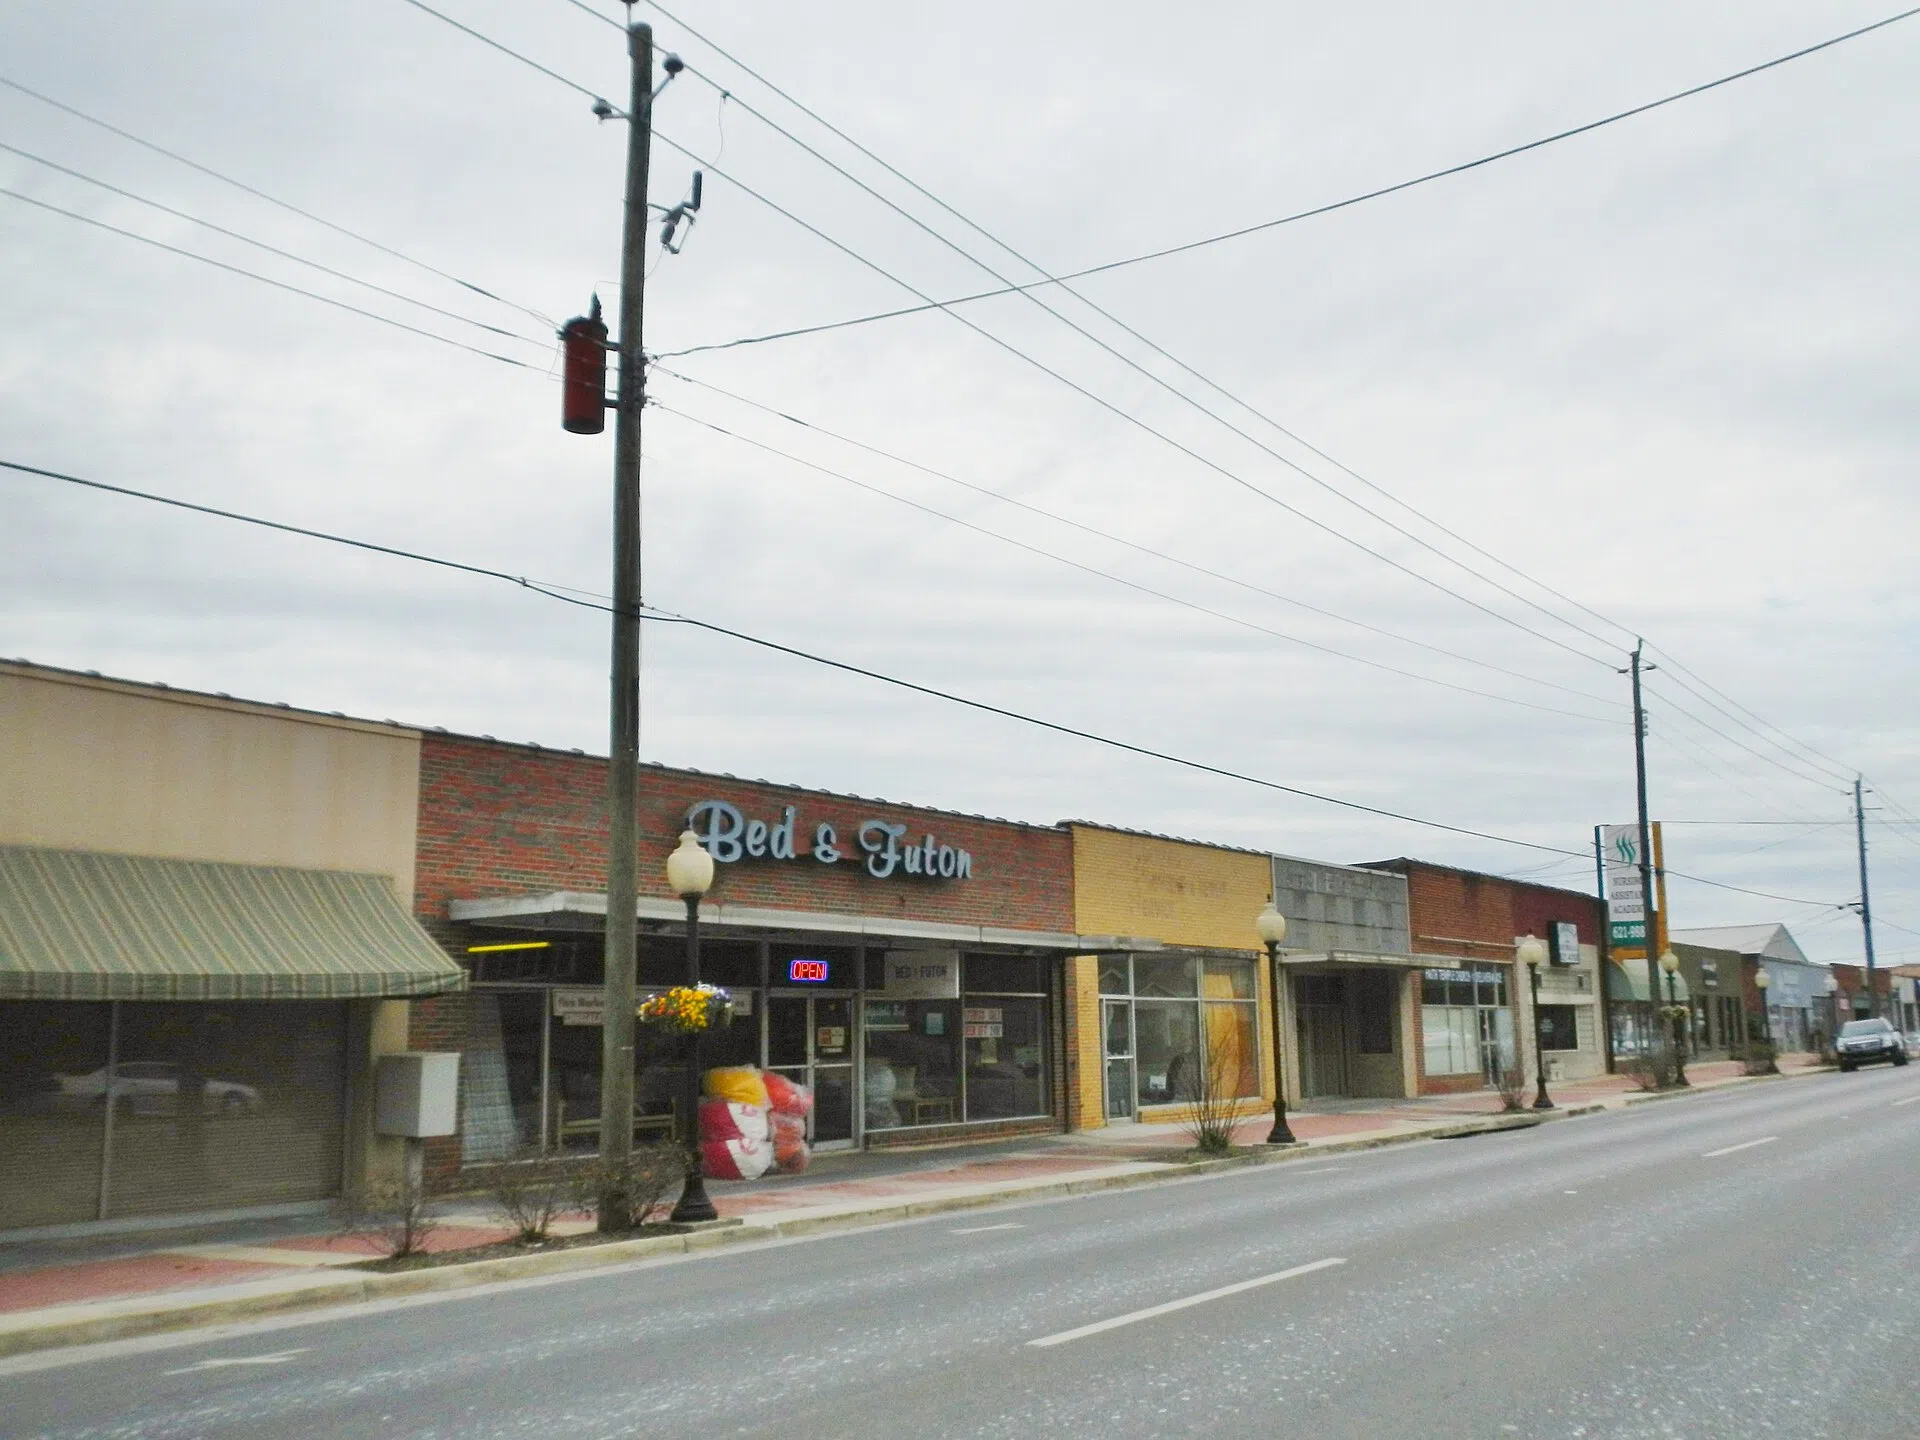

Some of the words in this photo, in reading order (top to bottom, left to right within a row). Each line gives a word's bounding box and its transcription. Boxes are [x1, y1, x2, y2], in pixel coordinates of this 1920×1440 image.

[688, 800, 796, 863] Bed
[814, 822, 841, 863] &
[859, 819, 973, 879] Futon
[1613, 877, 1642, 886] NURSIN
[1613, 905, 1645, 914] ACADEM
[792, 960, 826, 980] OPEN
